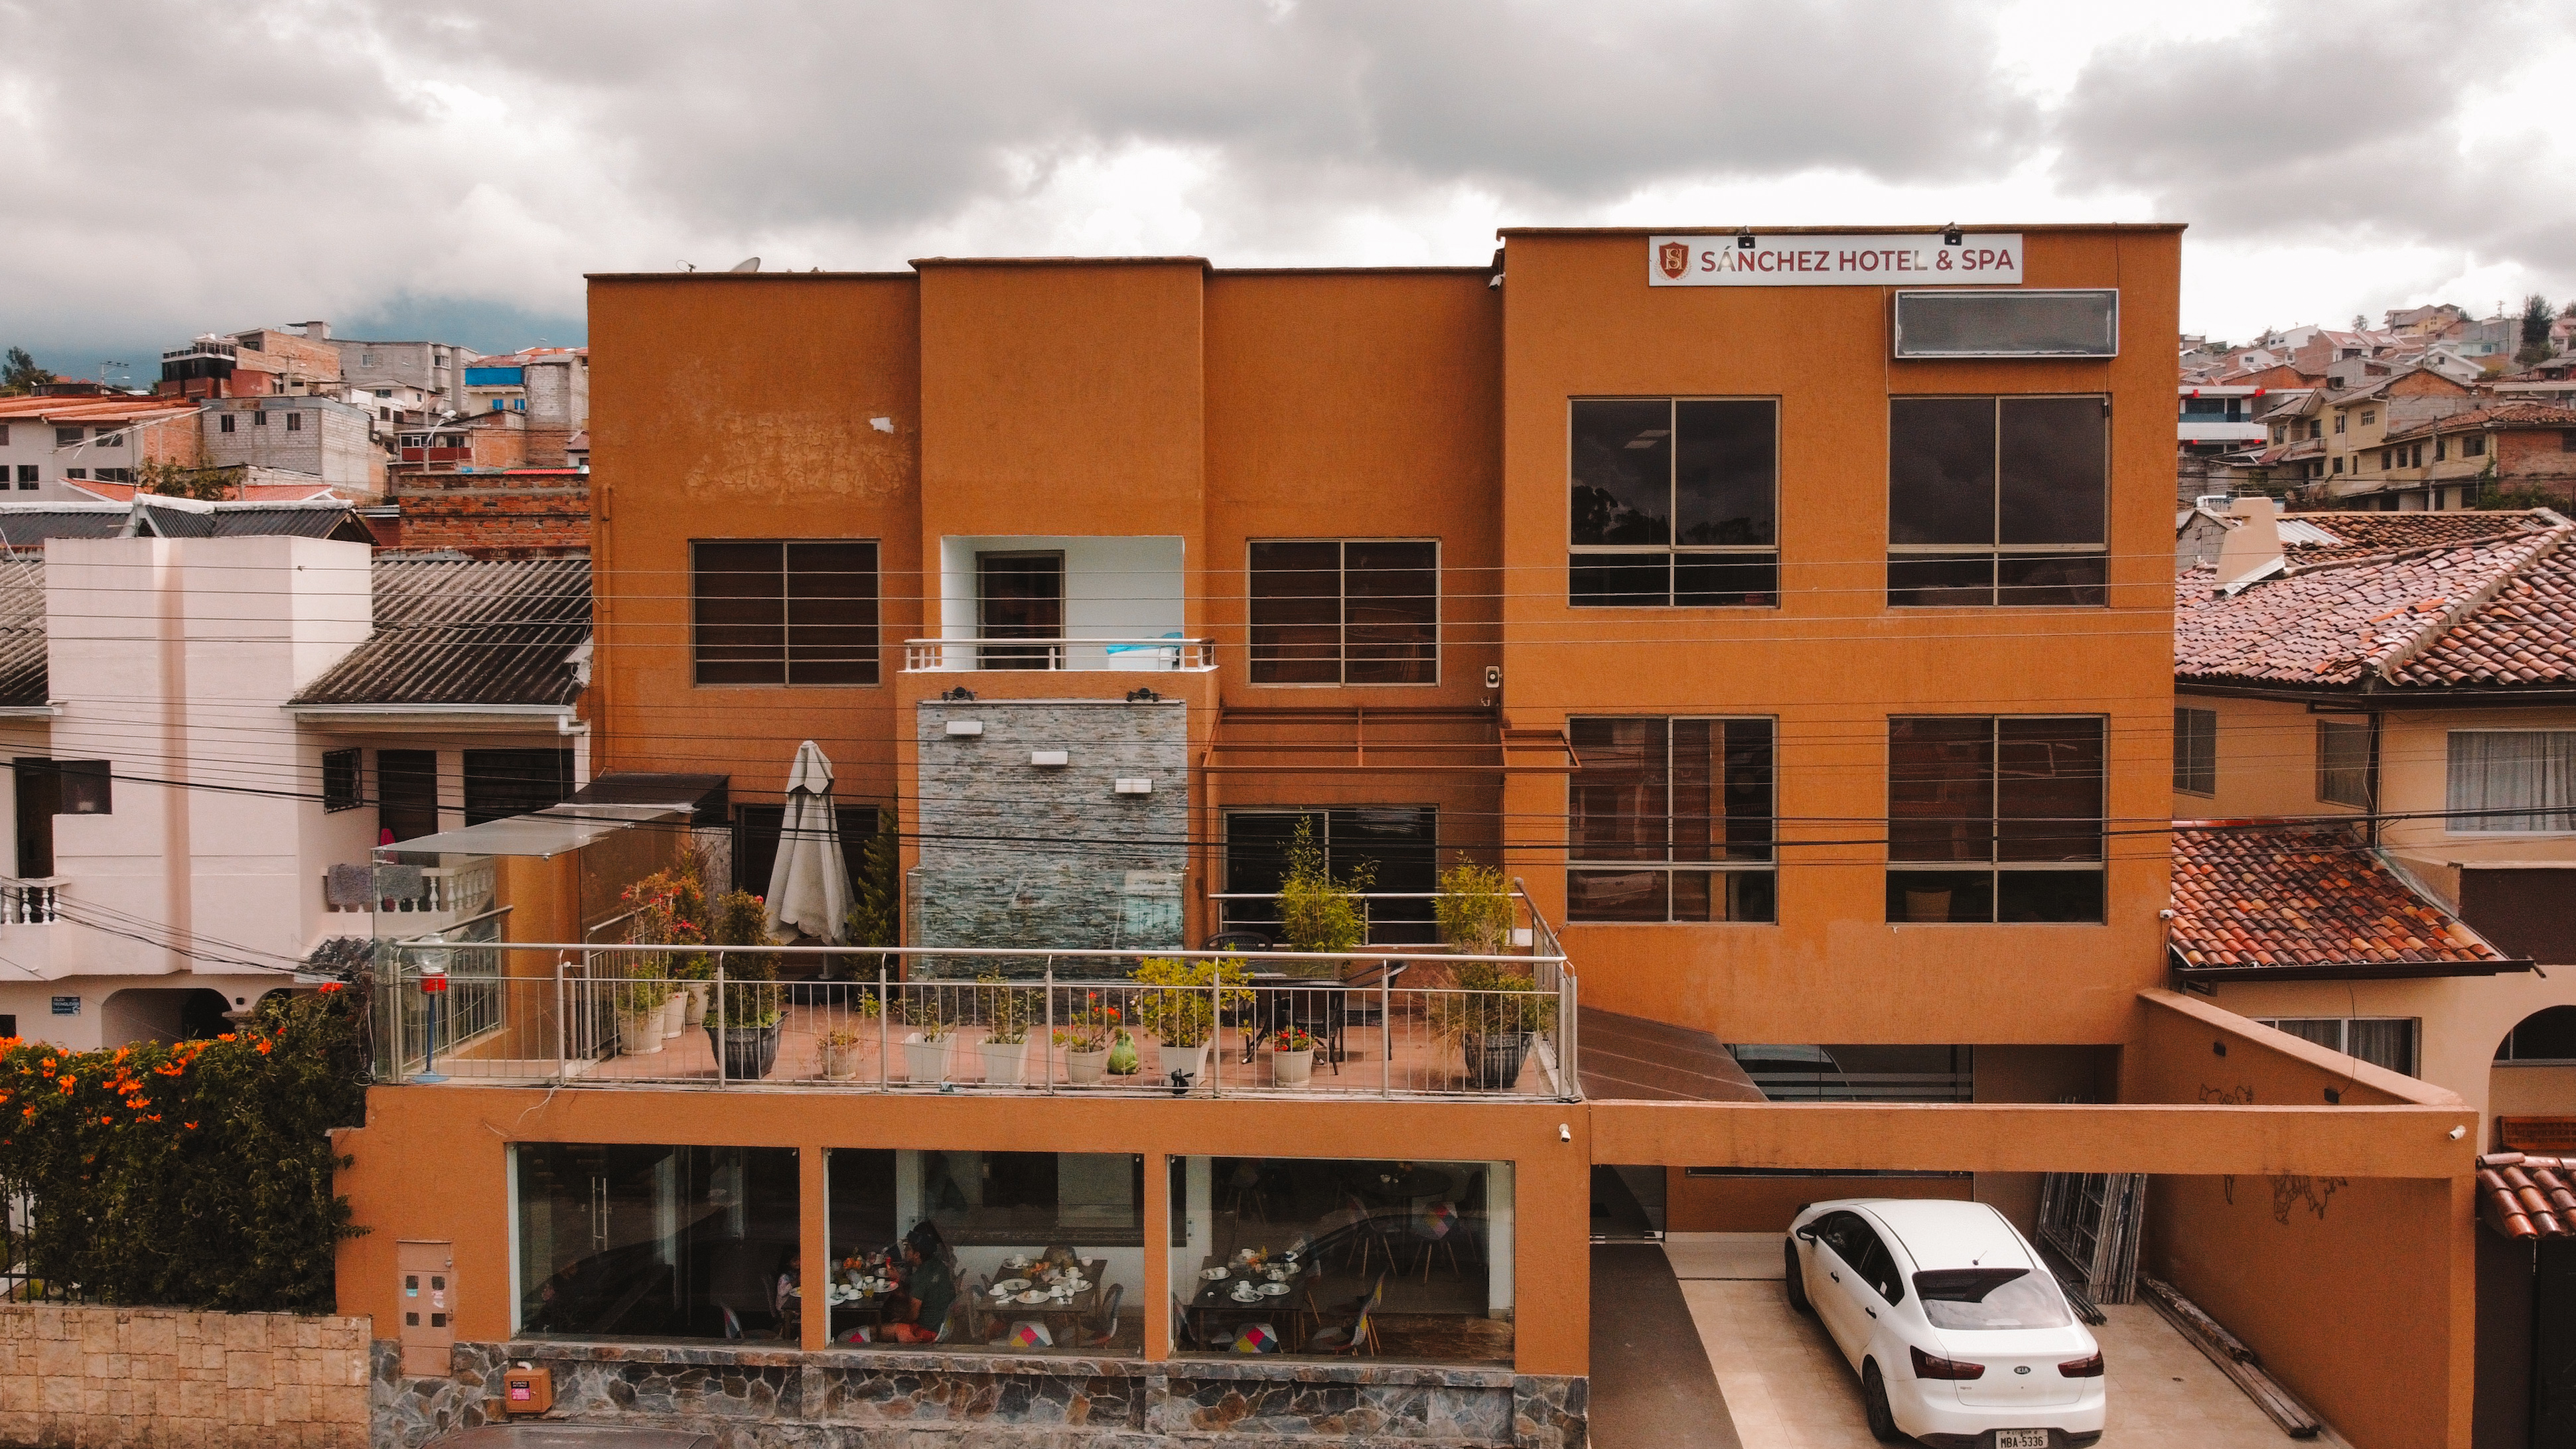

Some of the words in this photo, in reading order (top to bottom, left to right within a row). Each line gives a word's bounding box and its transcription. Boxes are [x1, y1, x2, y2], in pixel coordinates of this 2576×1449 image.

[1701, 245, 1830, 272] SÁNCHEZ
[1839, 250, 1928, 271] HOTEL
[1936, 249, 1953, 271] &
[1961, 249, 2015, 271] SPA
[2000, 1436, 2043, 1448] MBA-5336
